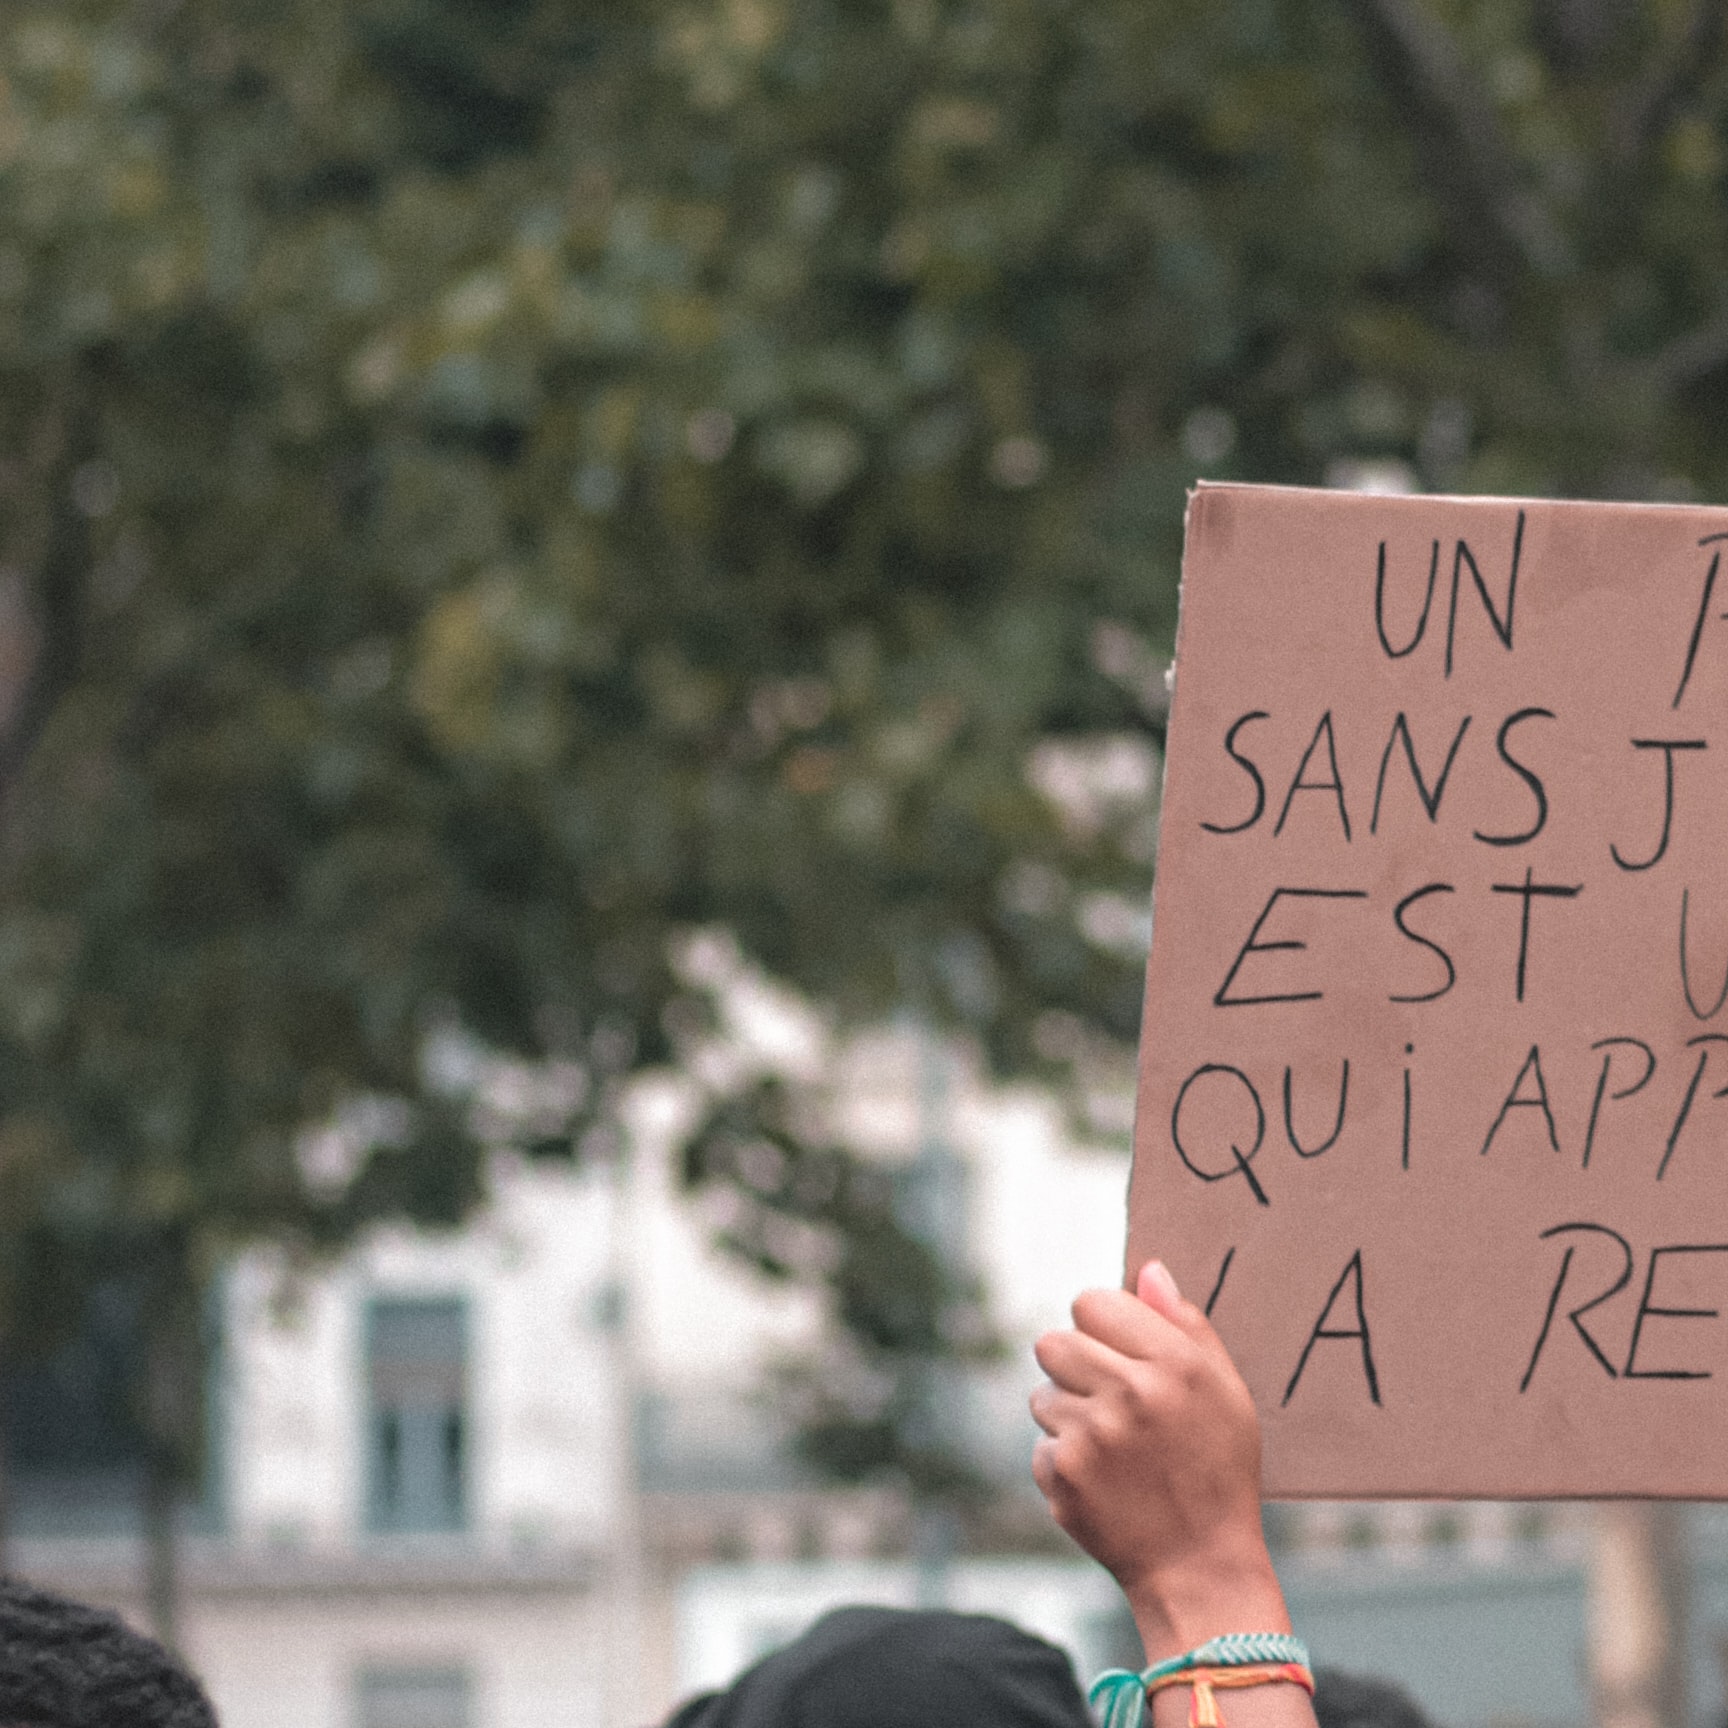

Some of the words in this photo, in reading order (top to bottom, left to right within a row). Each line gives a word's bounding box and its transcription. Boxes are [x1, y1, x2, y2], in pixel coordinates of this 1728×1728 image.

[1374, 511, 1526, 679] UN
[1199, 706, 1556, 848] SANS
[1212, 867, 1584, 1008] EST
